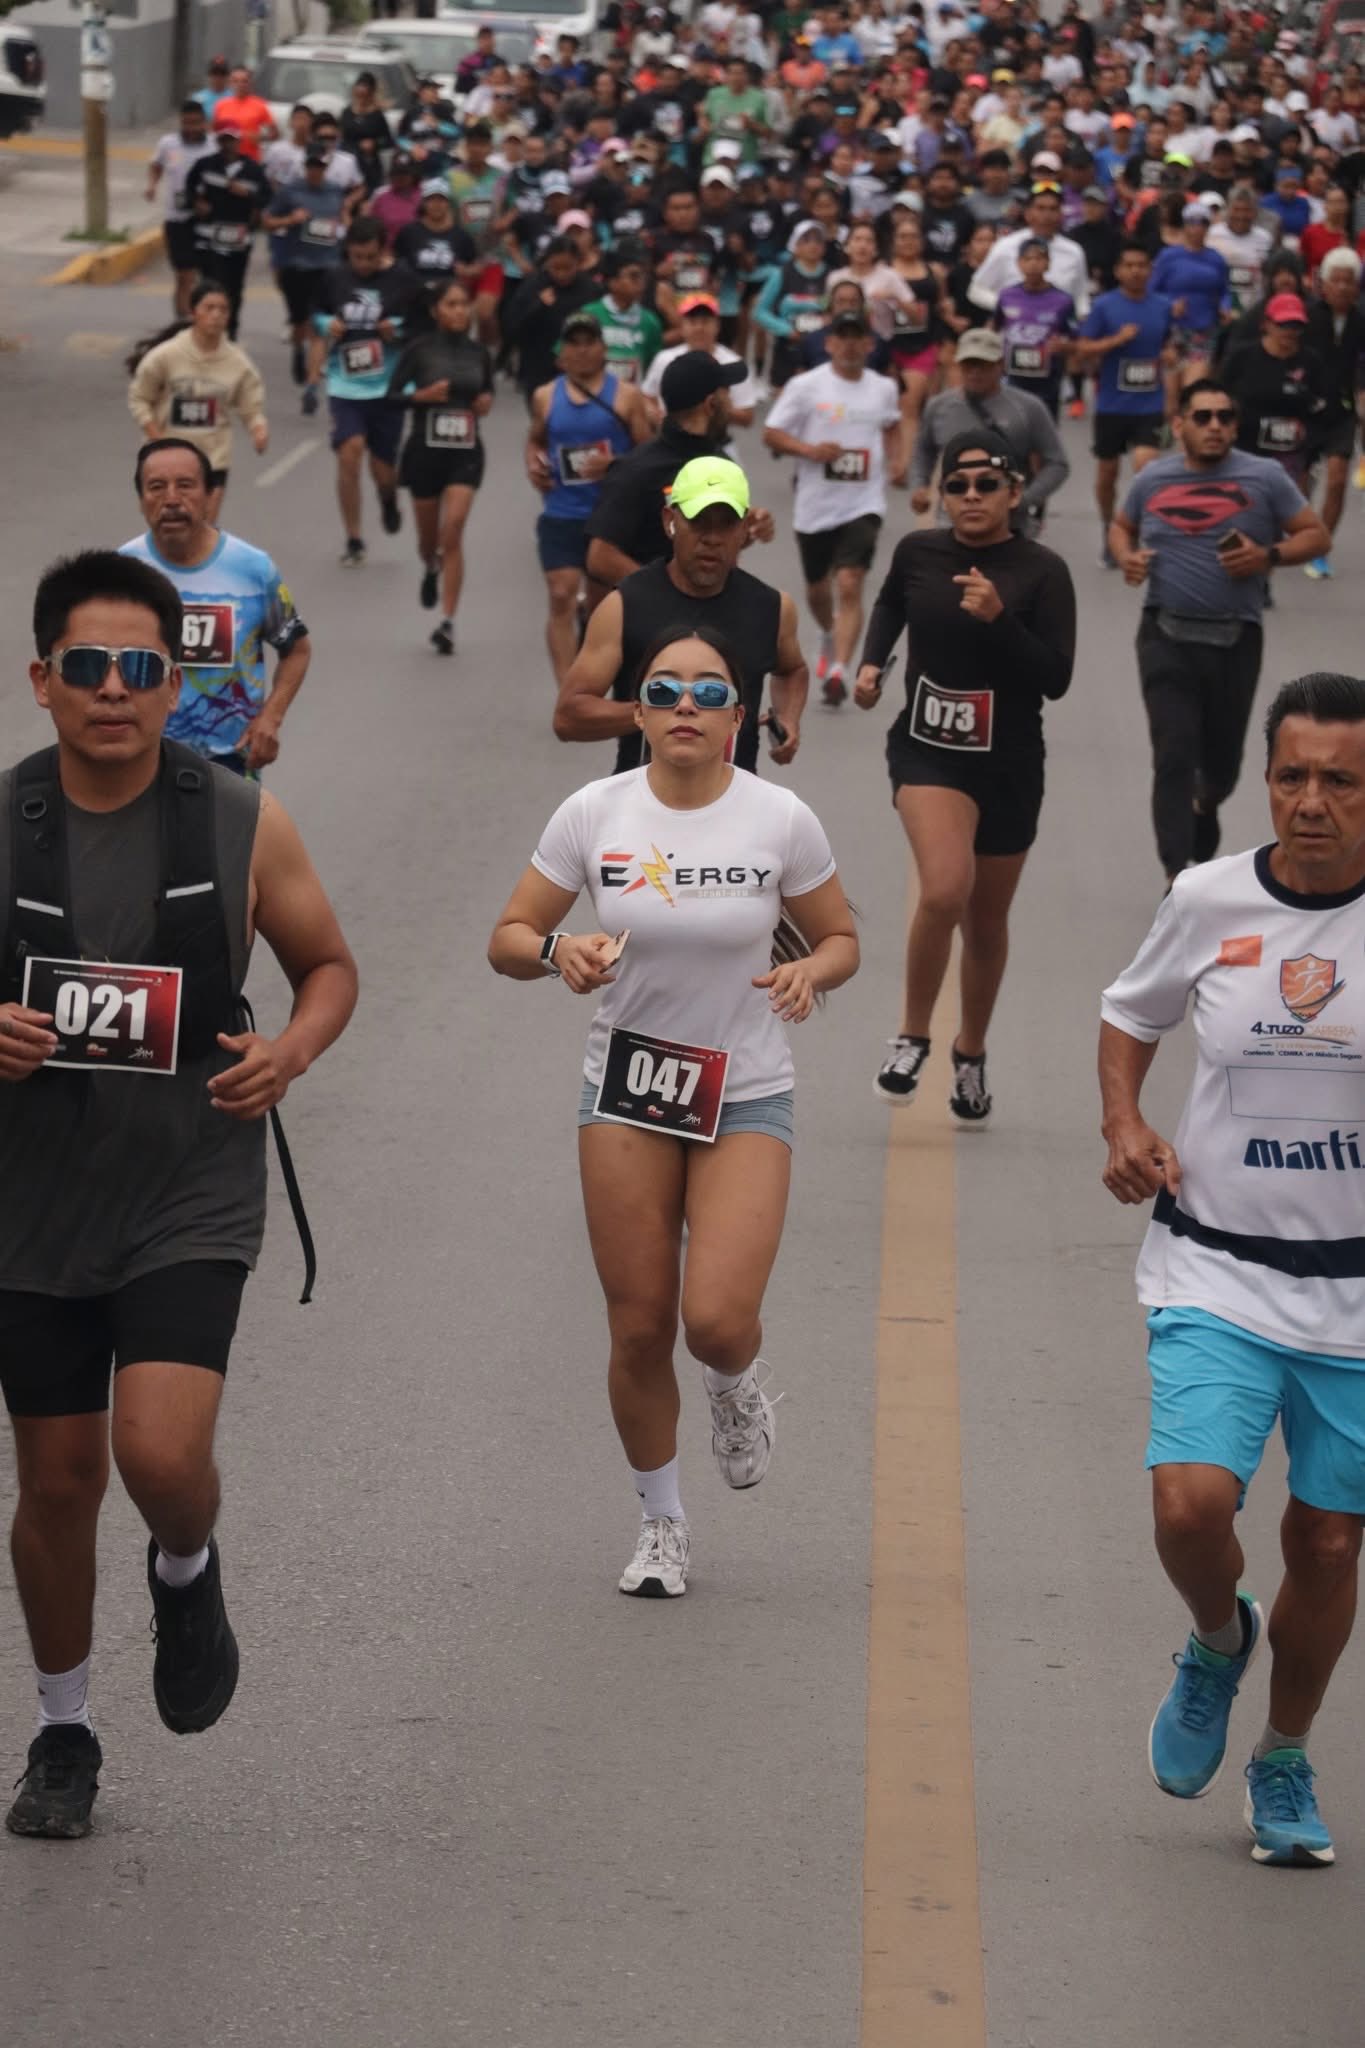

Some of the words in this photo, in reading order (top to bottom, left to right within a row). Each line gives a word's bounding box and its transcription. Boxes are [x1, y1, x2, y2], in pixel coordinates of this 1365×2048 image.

[925, 696, 975, 732] 073
[55, 981, 148, 1040] 021
[626, 1050, 702, 1106] 047
